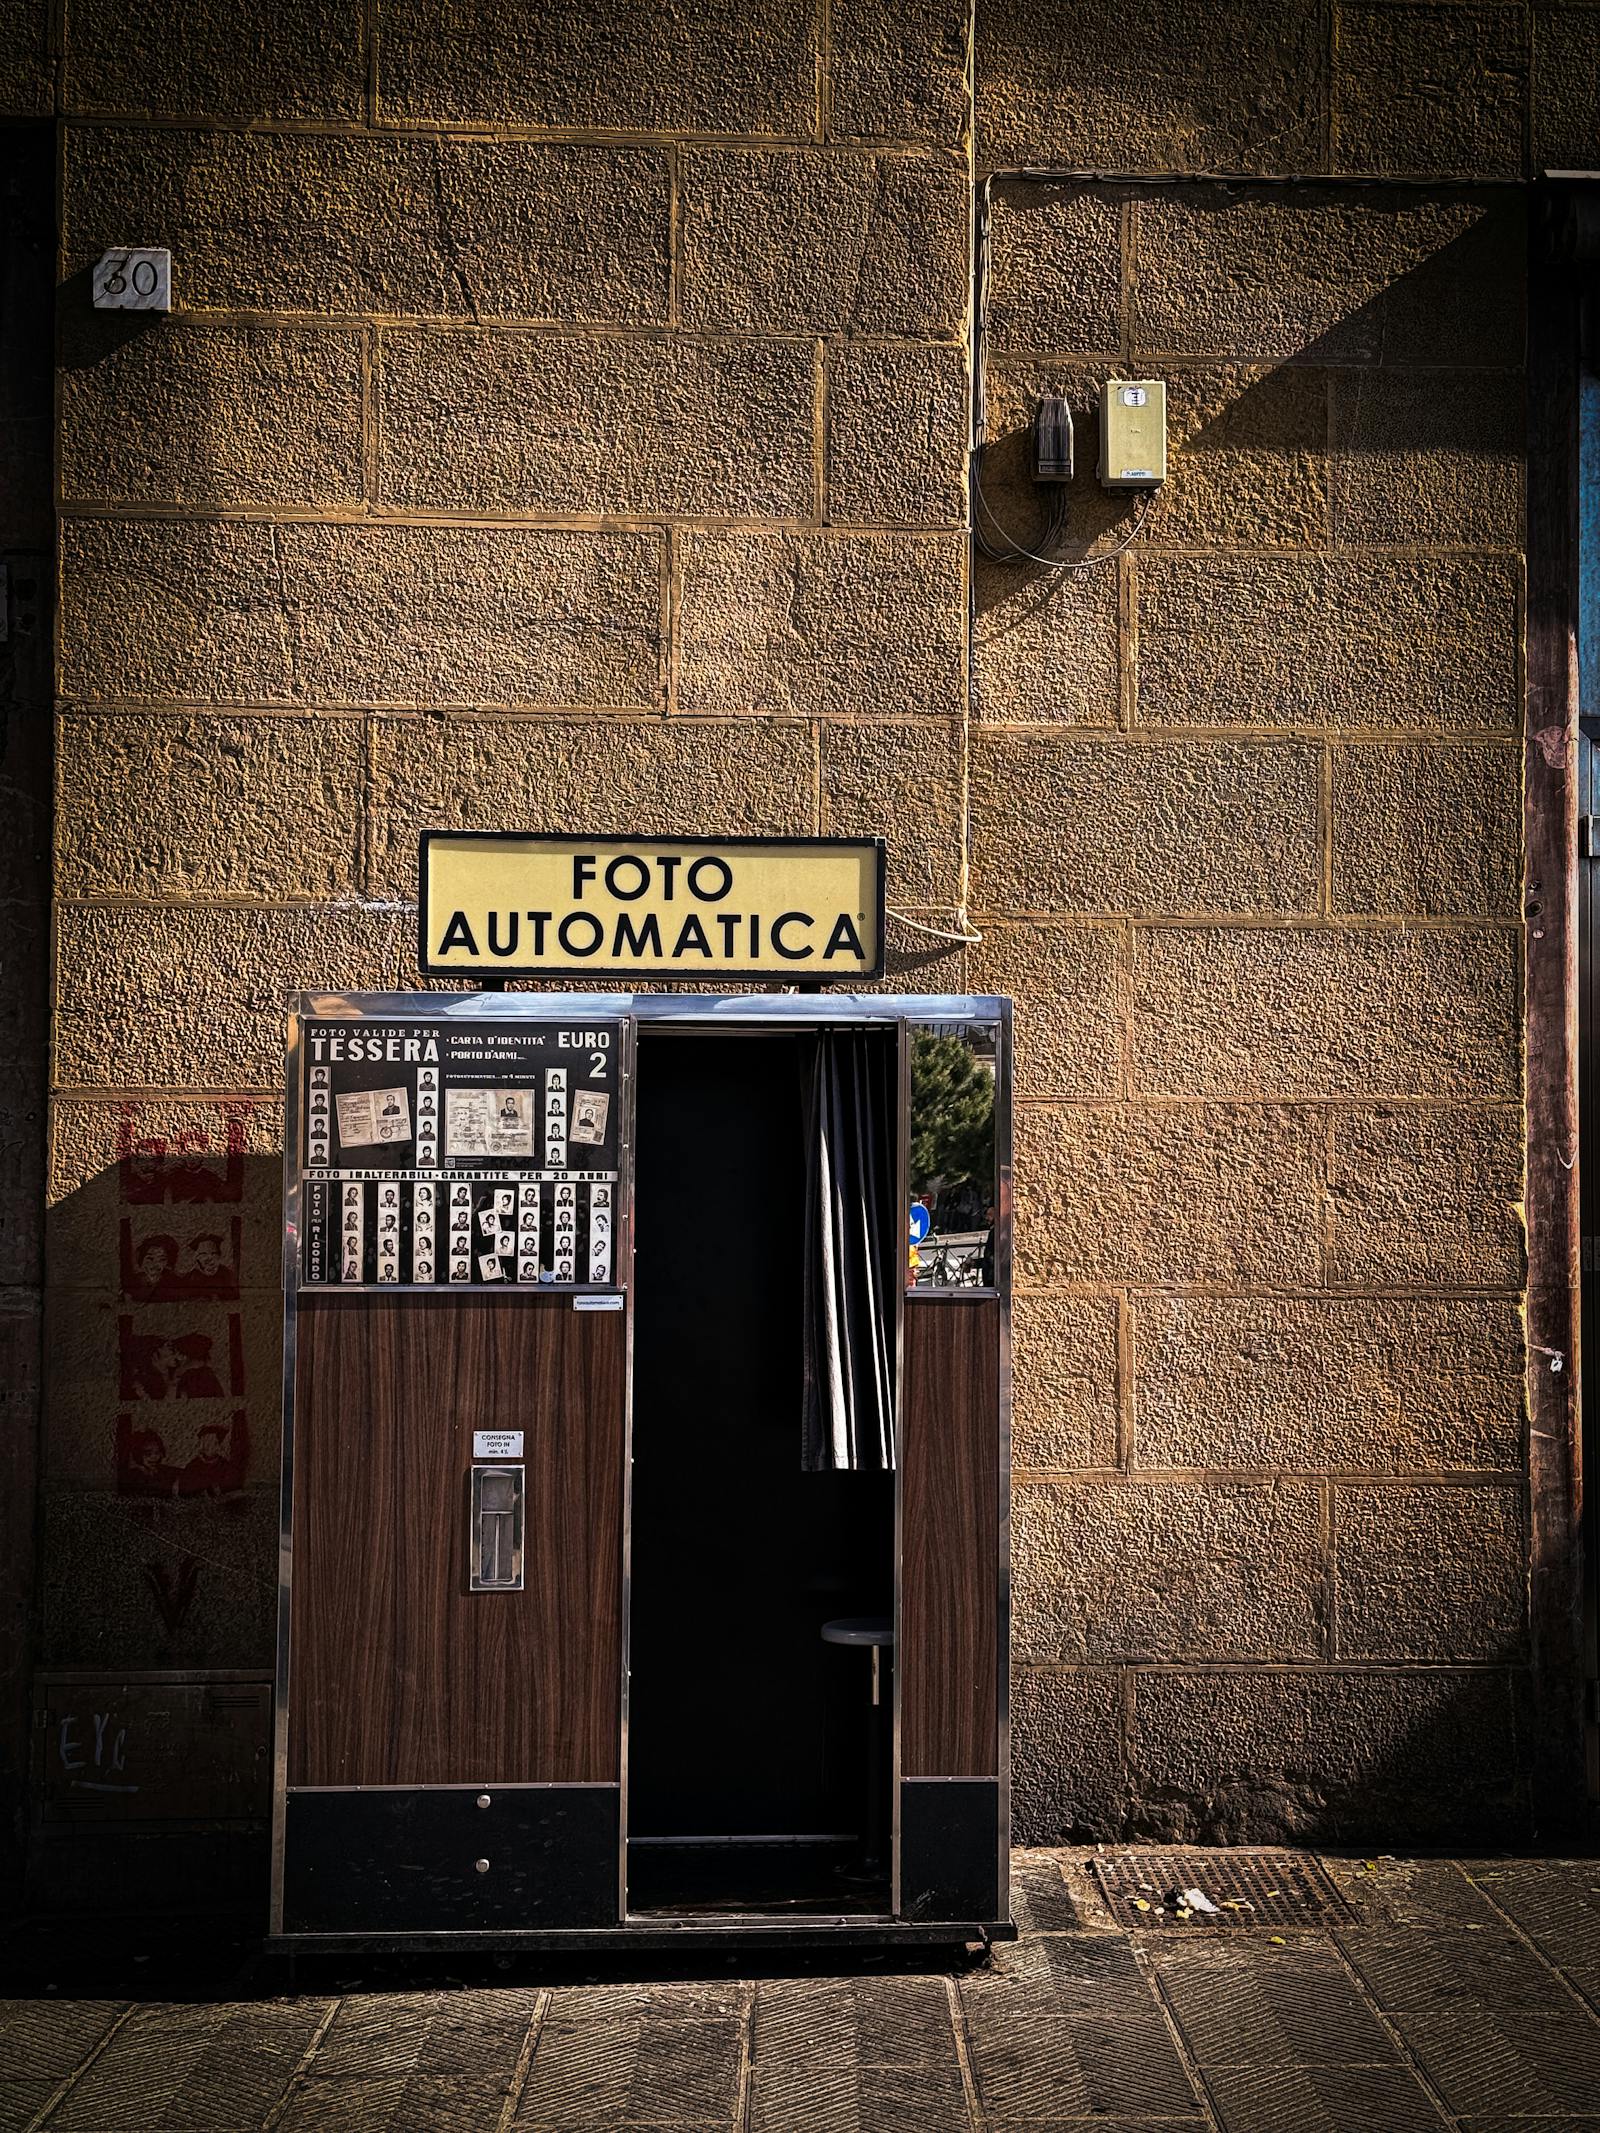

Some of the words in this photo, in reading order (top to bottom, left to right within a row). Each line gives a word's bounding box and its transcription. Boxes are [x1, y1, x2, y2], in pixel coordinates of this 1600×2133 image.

[103, 259, 158, 296] 30
[573, 854, 733, 902] FOTO
[438, 911, 866, 960] AUTOMATICA
[310, 1028, 347, 1037] FOTO
[353, 1028, 406, 1037] VALIDE
[413, 1029, 440, 1037] PER
[450, 1036, 483, 1045] CARTA
[558, 1031, 610, 1048] EURO
[310, 1038, 440, 1062] TESSERA
[450, 1051, 483, 1060] PORTO
[588, 1051, 607, 1079] 2
[309, 1170, 340, 1179] FOTO
[349, 1170, 433, 1179] INALTERABILI
[441, 1171, 509, 1180] GARANTITE
[519, 1171, 543, 1180] PER
[553, 1171, 569, 1180] 20
[579, 1172, 609, 1180] ANNI
[312, 1185, 322, 1216] FOTO
[311, 1226, 321, 1280] RICORDO
